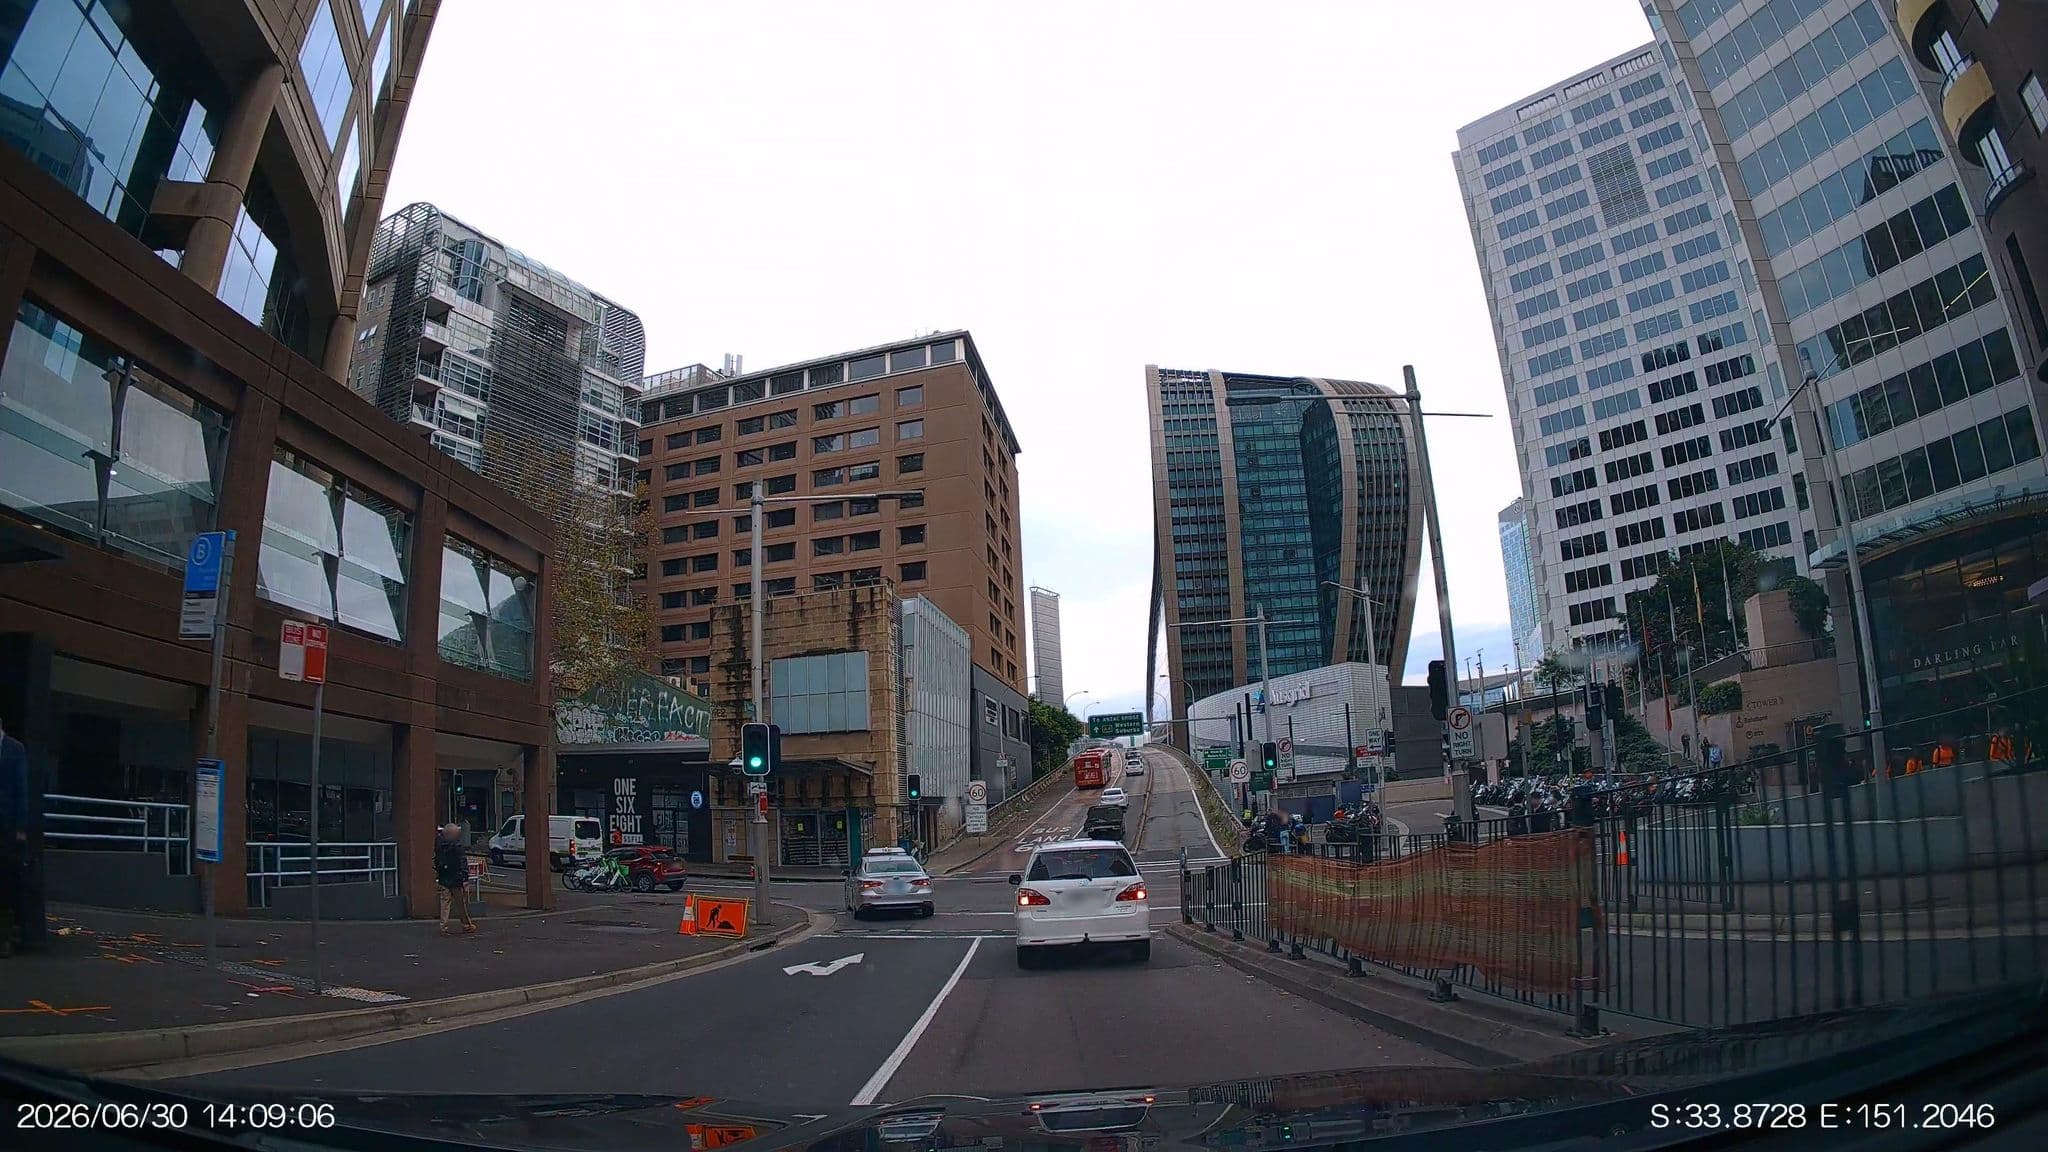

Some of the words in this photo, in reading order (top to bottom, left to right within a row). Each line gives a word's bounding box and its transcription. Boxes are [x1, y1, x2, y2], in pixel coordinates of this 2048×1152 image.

[285, 626, 303, 634] BUS
[1913, 643, 1981, 668] DARLING
[1455, 731, 1468, 740] NO
[1453, 740, 1472, 749] RIGHT
[1454, 748, 1472, 756] TURN
[1233, 766, 1246, 776] 60
[614, 777, 637, 796] ONE
[972, 788, 983, 798] 60
[615, 796, 635, 814] SIX
[609, 815, 642, 833] EIGHT
[1032, 826, 1072, 834] BUS
[1018, 834, 1070, 844] LANE
